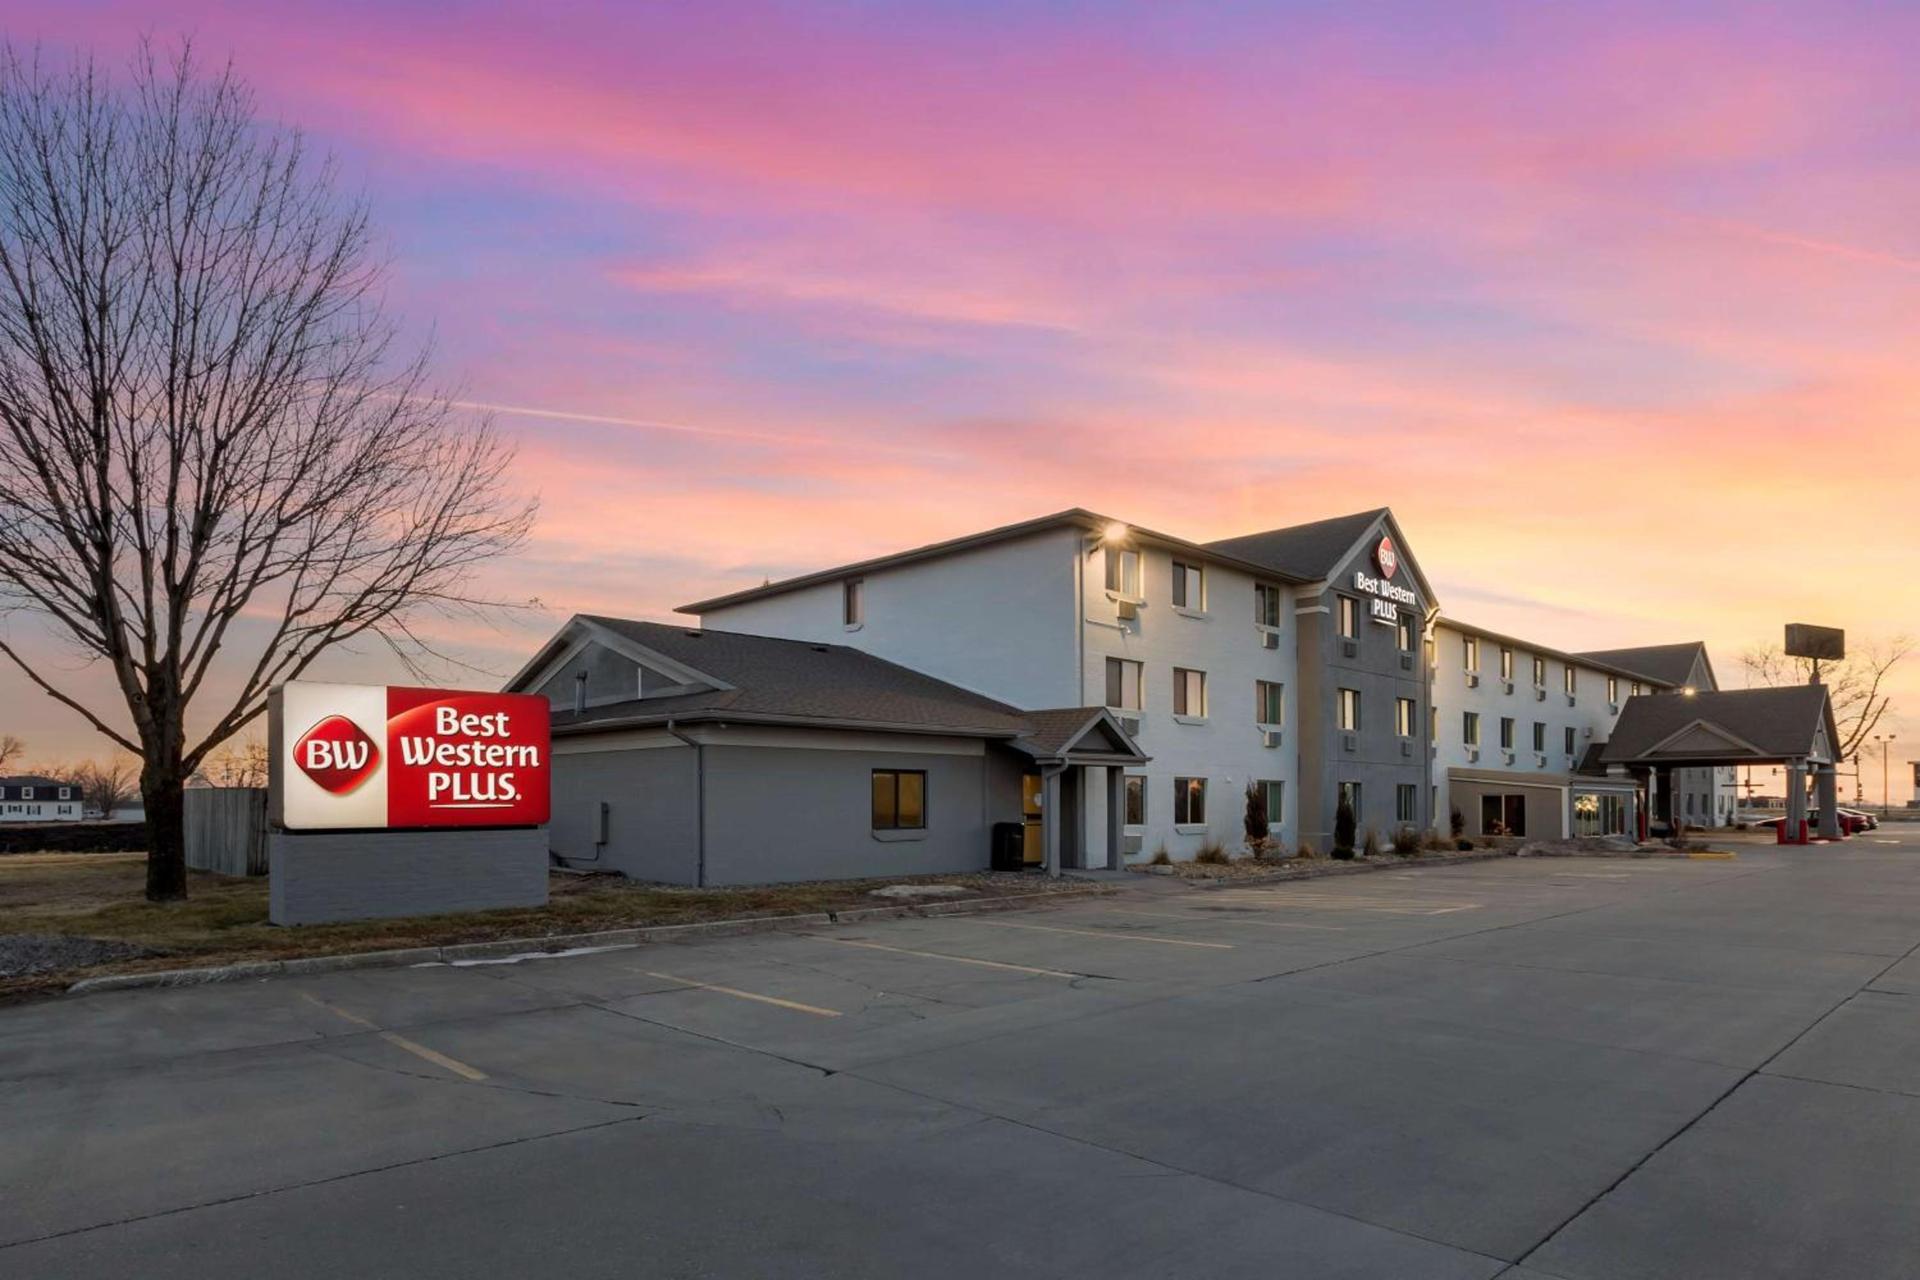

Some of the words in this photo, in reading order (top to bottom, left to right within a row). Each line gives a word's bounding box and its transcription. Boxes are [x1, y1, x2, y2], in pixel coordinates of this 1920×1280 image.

[1357, 572, 1378, 594] Best
[1381, 580, 1415, 605] Western
[1374, 599, 1397, 620] PLUS
[436, 706, 511, 737] Best
[306, 740, 369, 770] BW
[400, 736, 539, 767] Western
